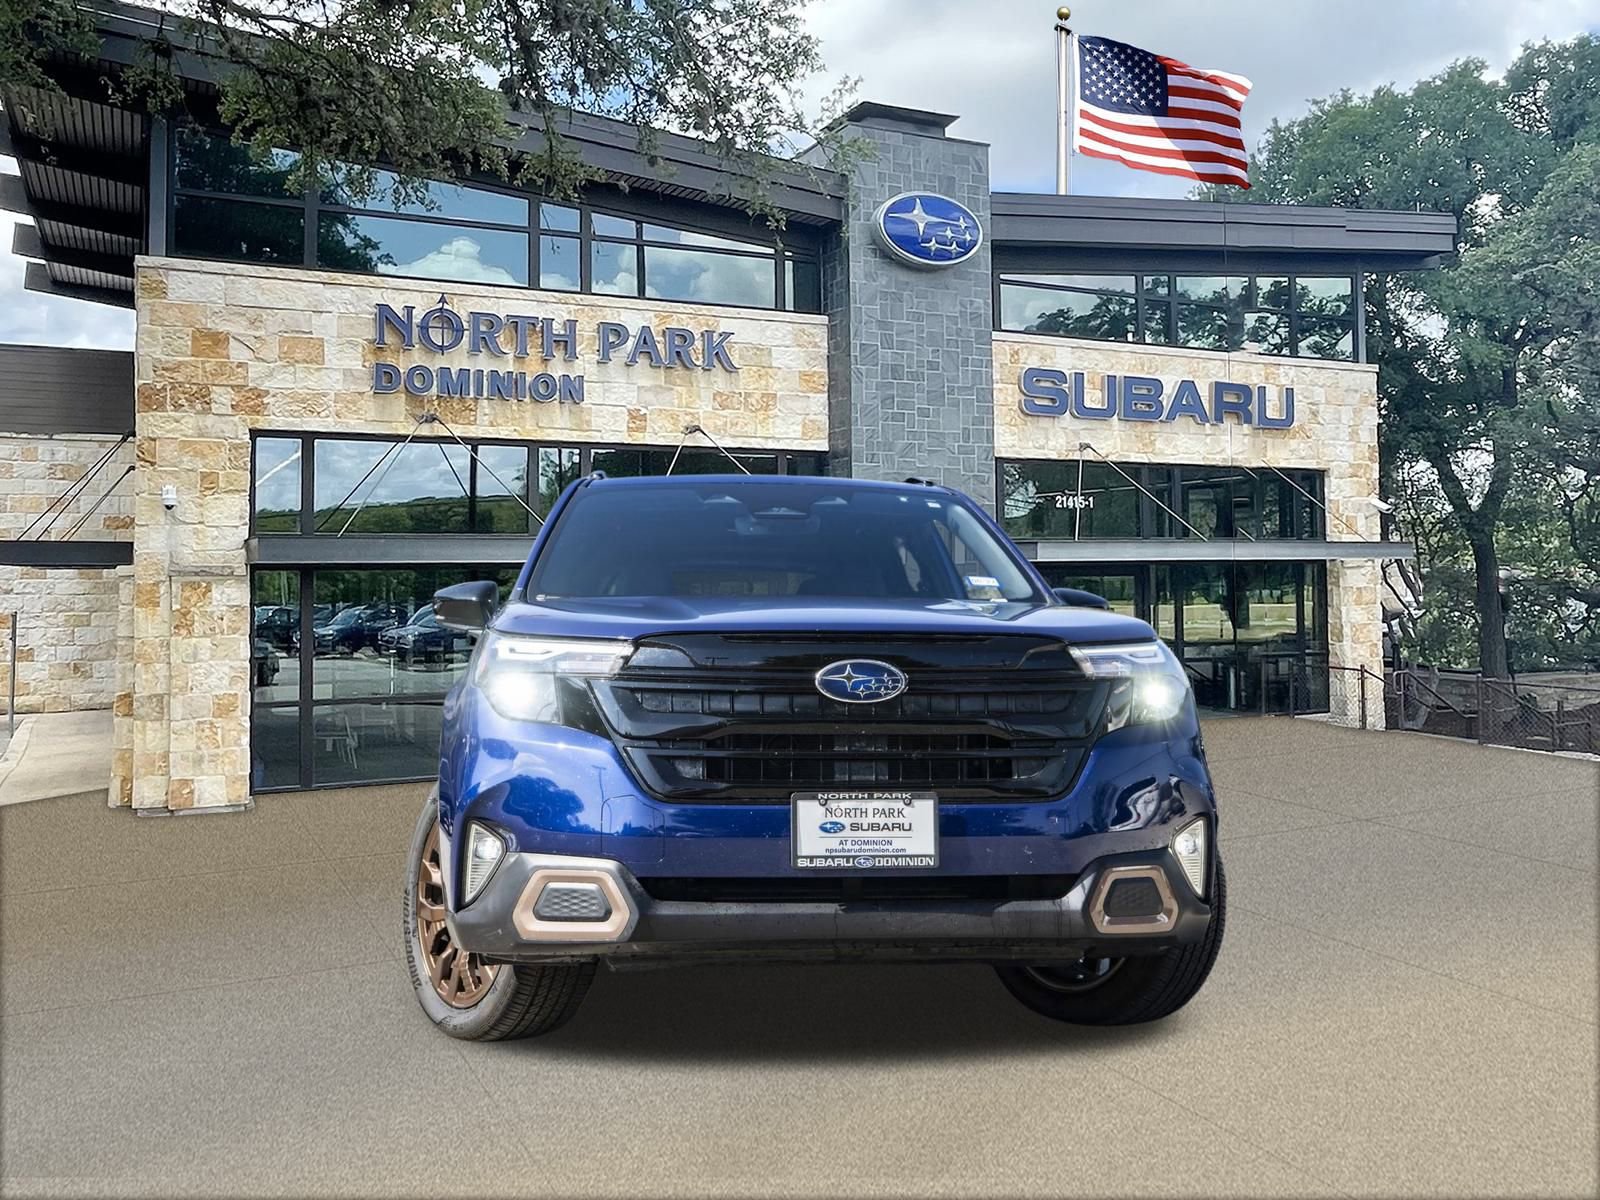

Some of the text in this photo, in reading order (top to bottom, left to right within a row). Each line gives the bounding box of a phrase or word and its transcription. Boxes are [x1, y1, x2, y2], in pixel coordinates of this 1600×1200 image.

[374, 293, 742, 373] NORTH PARK
[373, 362, 585, 404] DOMINION
[1019, 367, 1295, 430] SUBARU
[824, 805, 906, 819] NORTH PARK
[850, 822, 912, 832] SUBARU
[838, 839, 893, 847] AT DOMINION
[825, 846, 907, 854] npsubarudominion.com
[797, 857, 935, 867] SUBARU DOMINION
